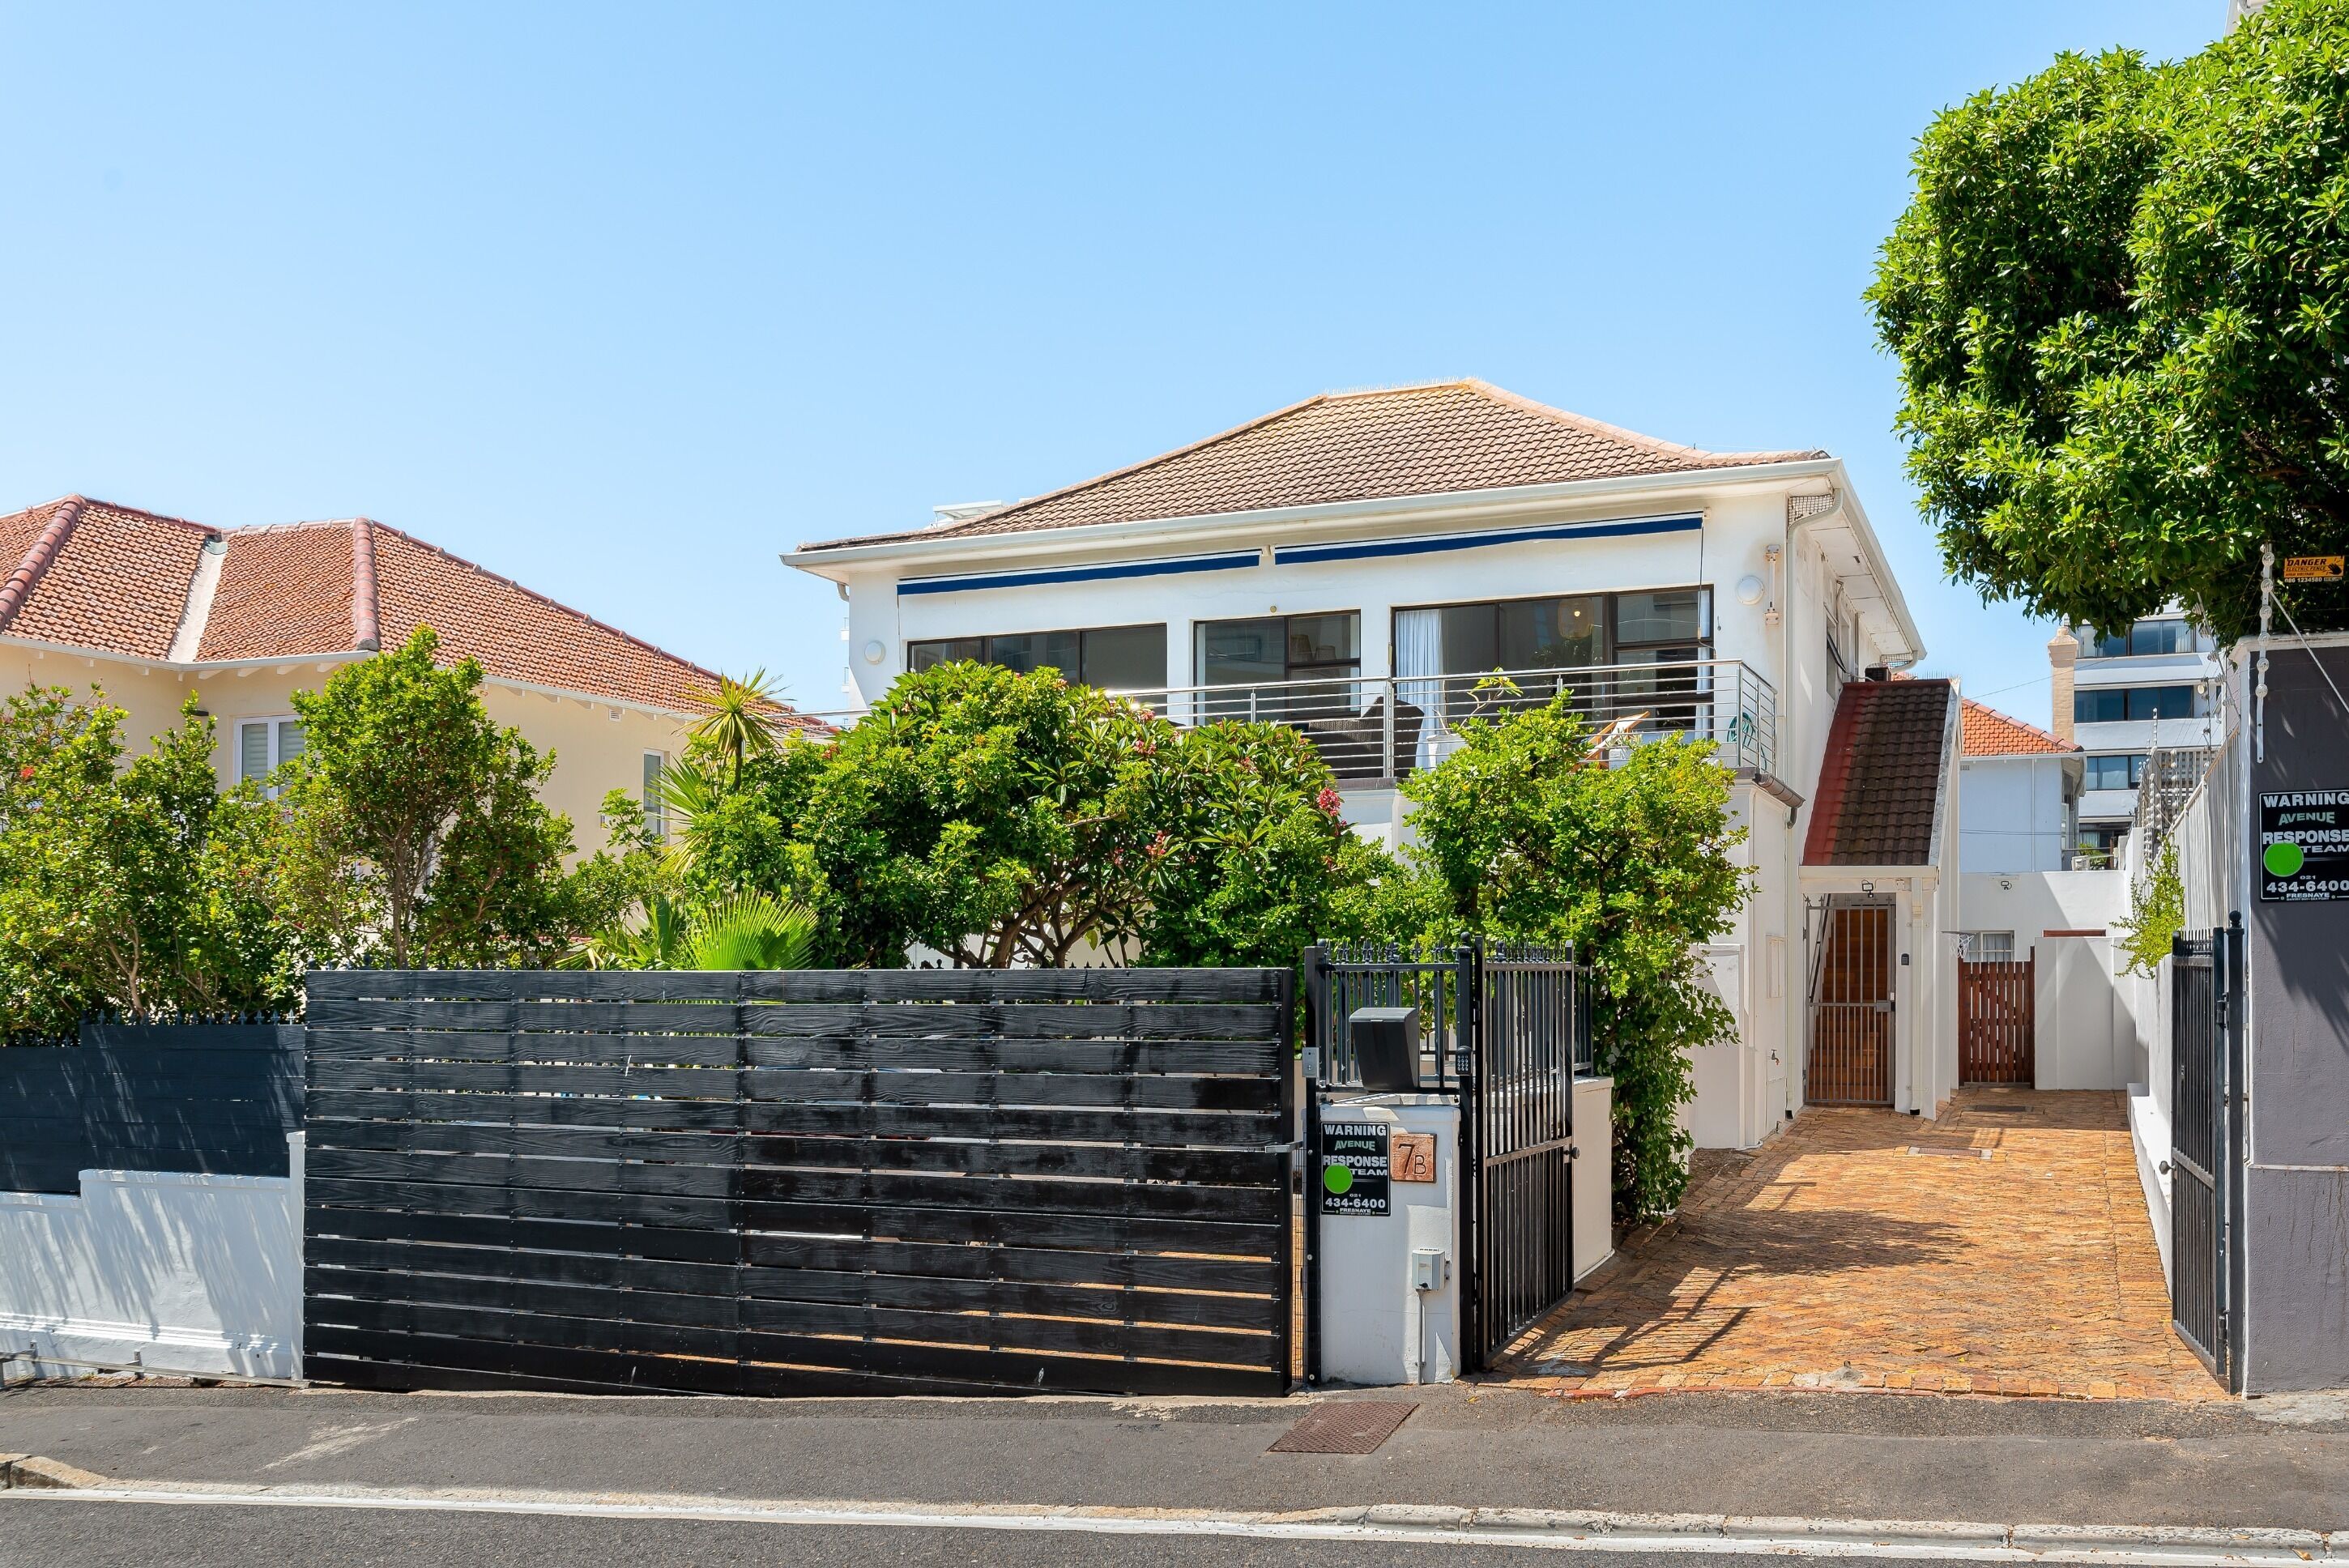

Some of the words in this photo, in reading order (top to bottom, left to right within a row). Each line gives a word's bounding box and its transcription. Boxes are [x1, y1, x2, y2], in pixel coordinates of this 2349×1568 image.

[2263, 792, 2349, 807] WARNING
[2278, 812, 2335, 826] AVENUE
[2262, 829, 2349, 845] RESPONSE
[2300, 845, 2349, 853] TEAM
[2266, 880, 2349, 893] 434-6400
[1324, 1125, 1387, 1136] WARNING
[1335, 1140, 1375, 1151] AVENUE
[1323, 1155, 1388, 1167] RESPONSE
[1398, 1143, 1426, 1174] 7B
[1325, 1198, 1386, 1208] 434-6400
